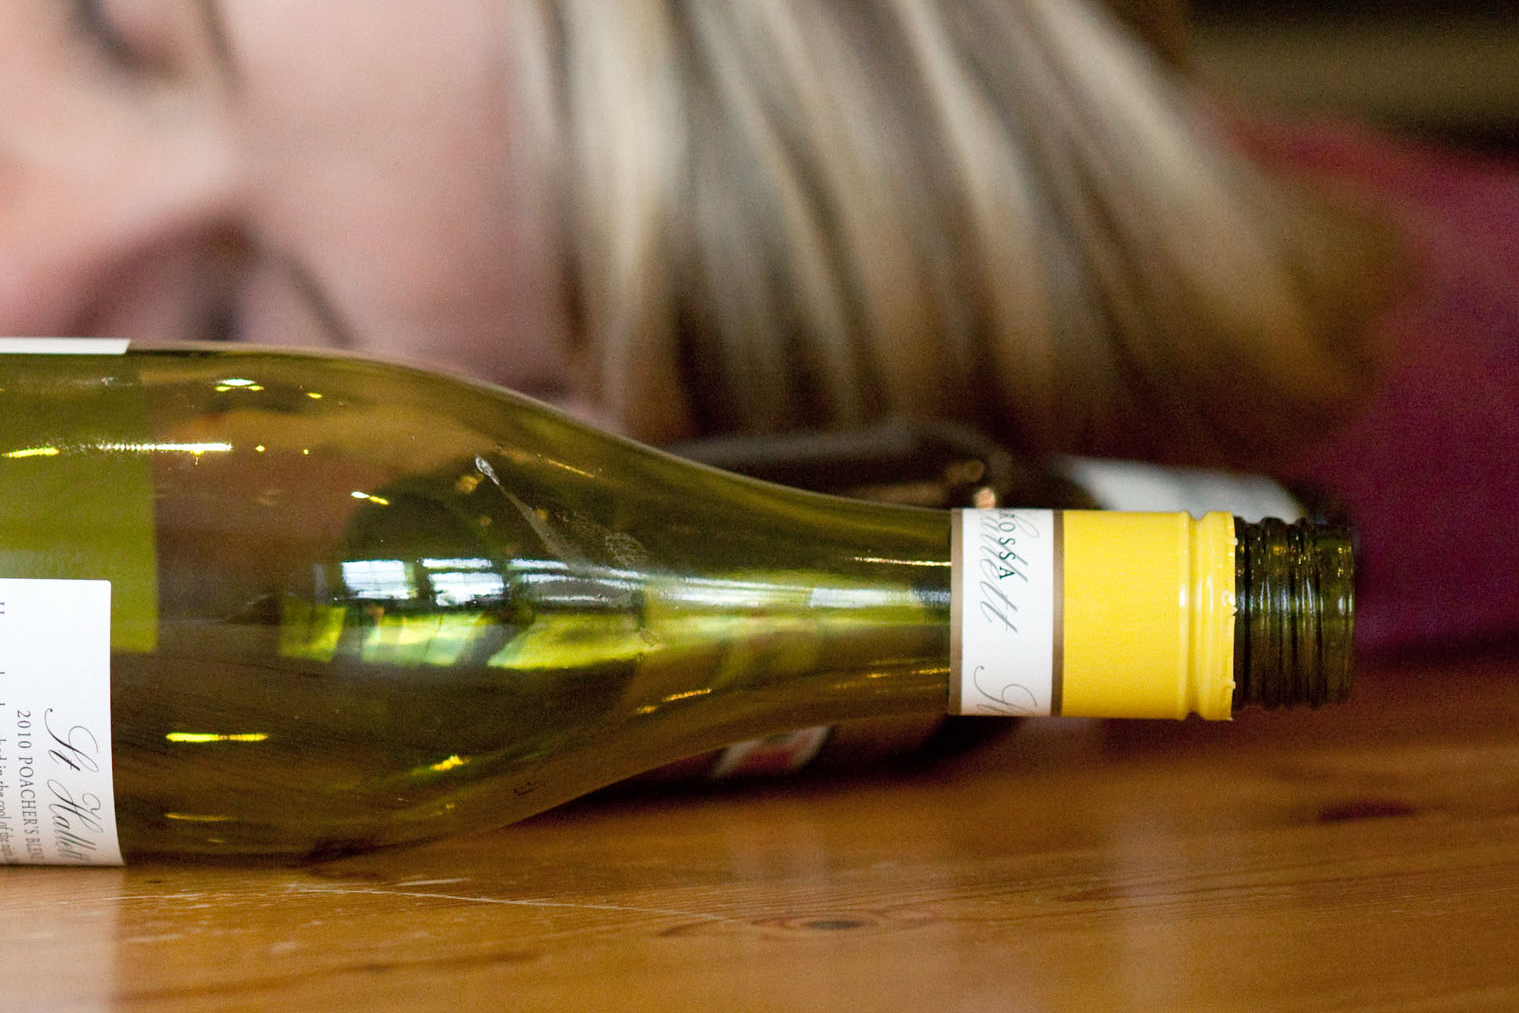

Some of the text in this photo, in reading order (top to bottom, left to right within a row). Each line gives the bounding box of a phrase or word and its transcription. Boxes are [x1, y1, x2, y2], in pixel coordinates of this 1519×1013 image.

[17, 709, 40, 835] 2010 POACHER'S
[44, 707, 99, 773] St
